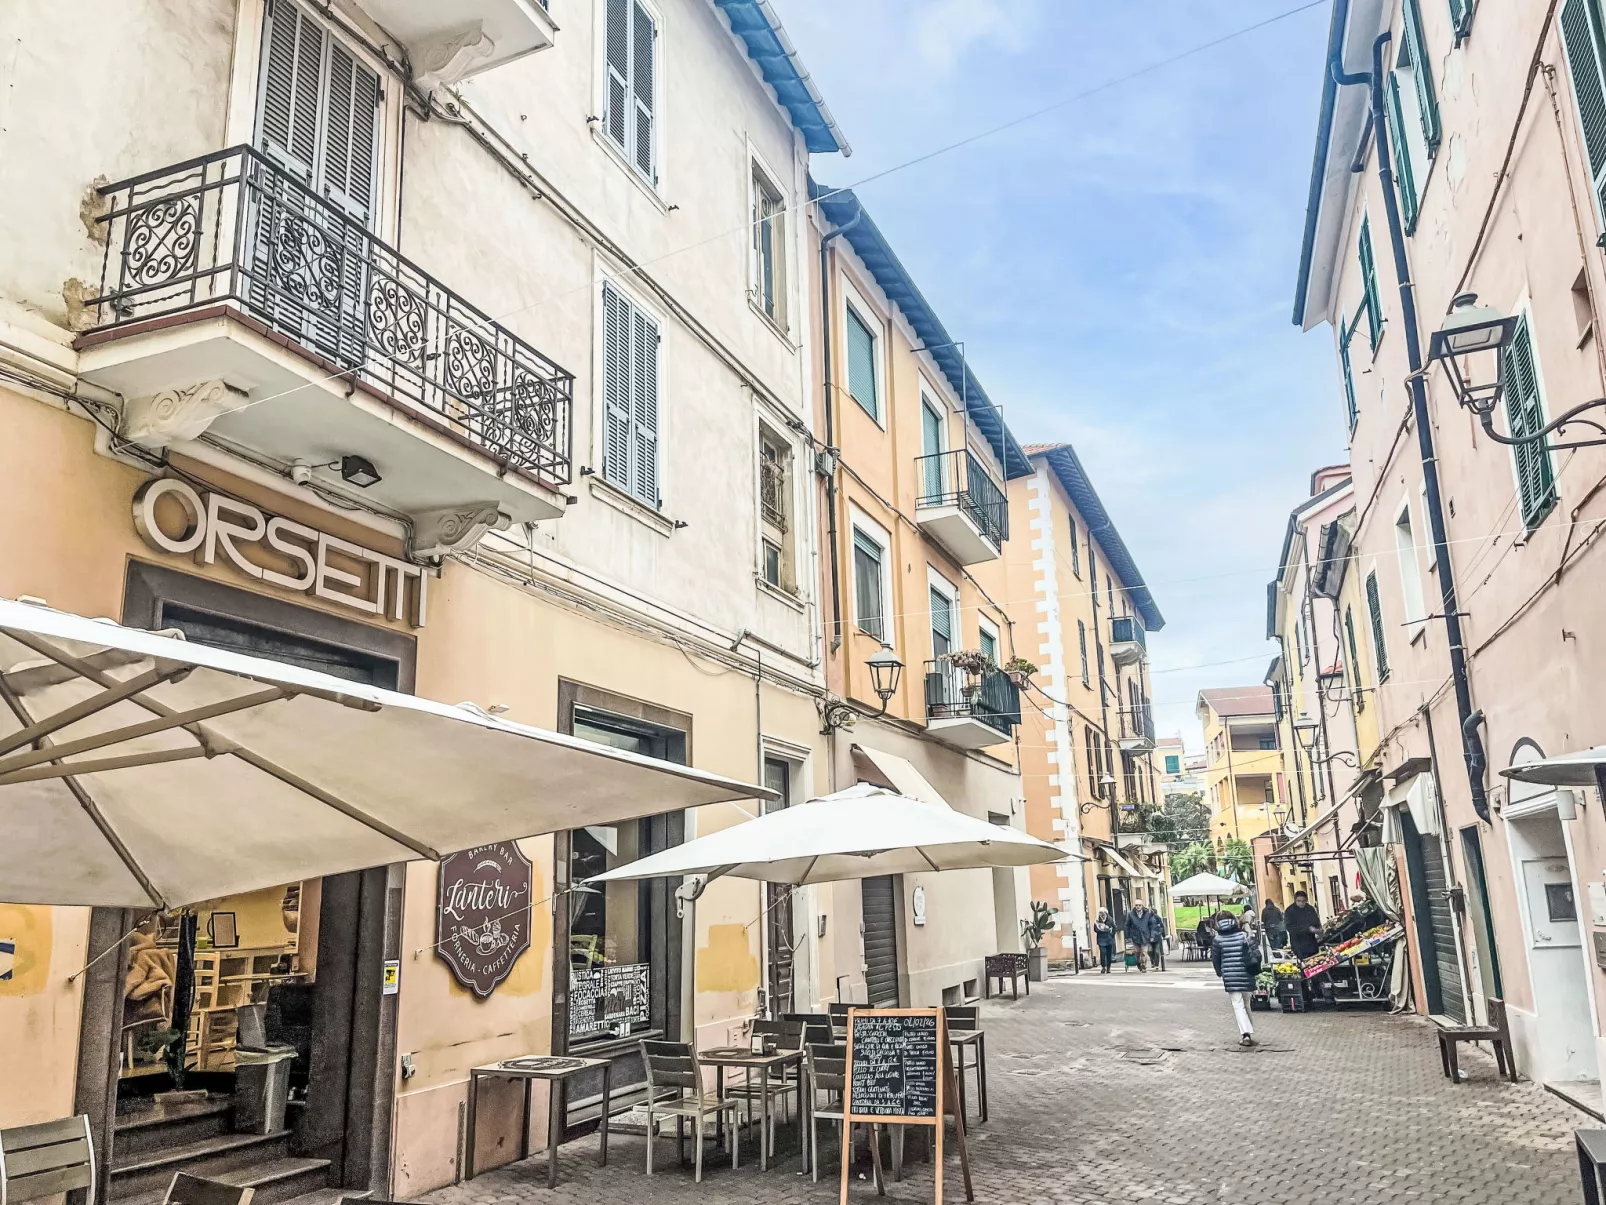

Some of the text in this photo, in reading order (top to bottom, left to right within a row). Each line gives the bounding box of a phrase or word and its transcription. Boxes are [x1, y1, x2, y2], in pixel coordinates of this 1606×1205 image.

[134, 478, 427, 628] ORSETTI
[499, 846, 513, 866] BAR
[444, 878, 527, 921] Lanteri
[450, 925, 475, 974] FORNERIA
[482, 923, 521, 975] CAFFETTERIA
[574, 987, 605, 1000] FOCACCIA
